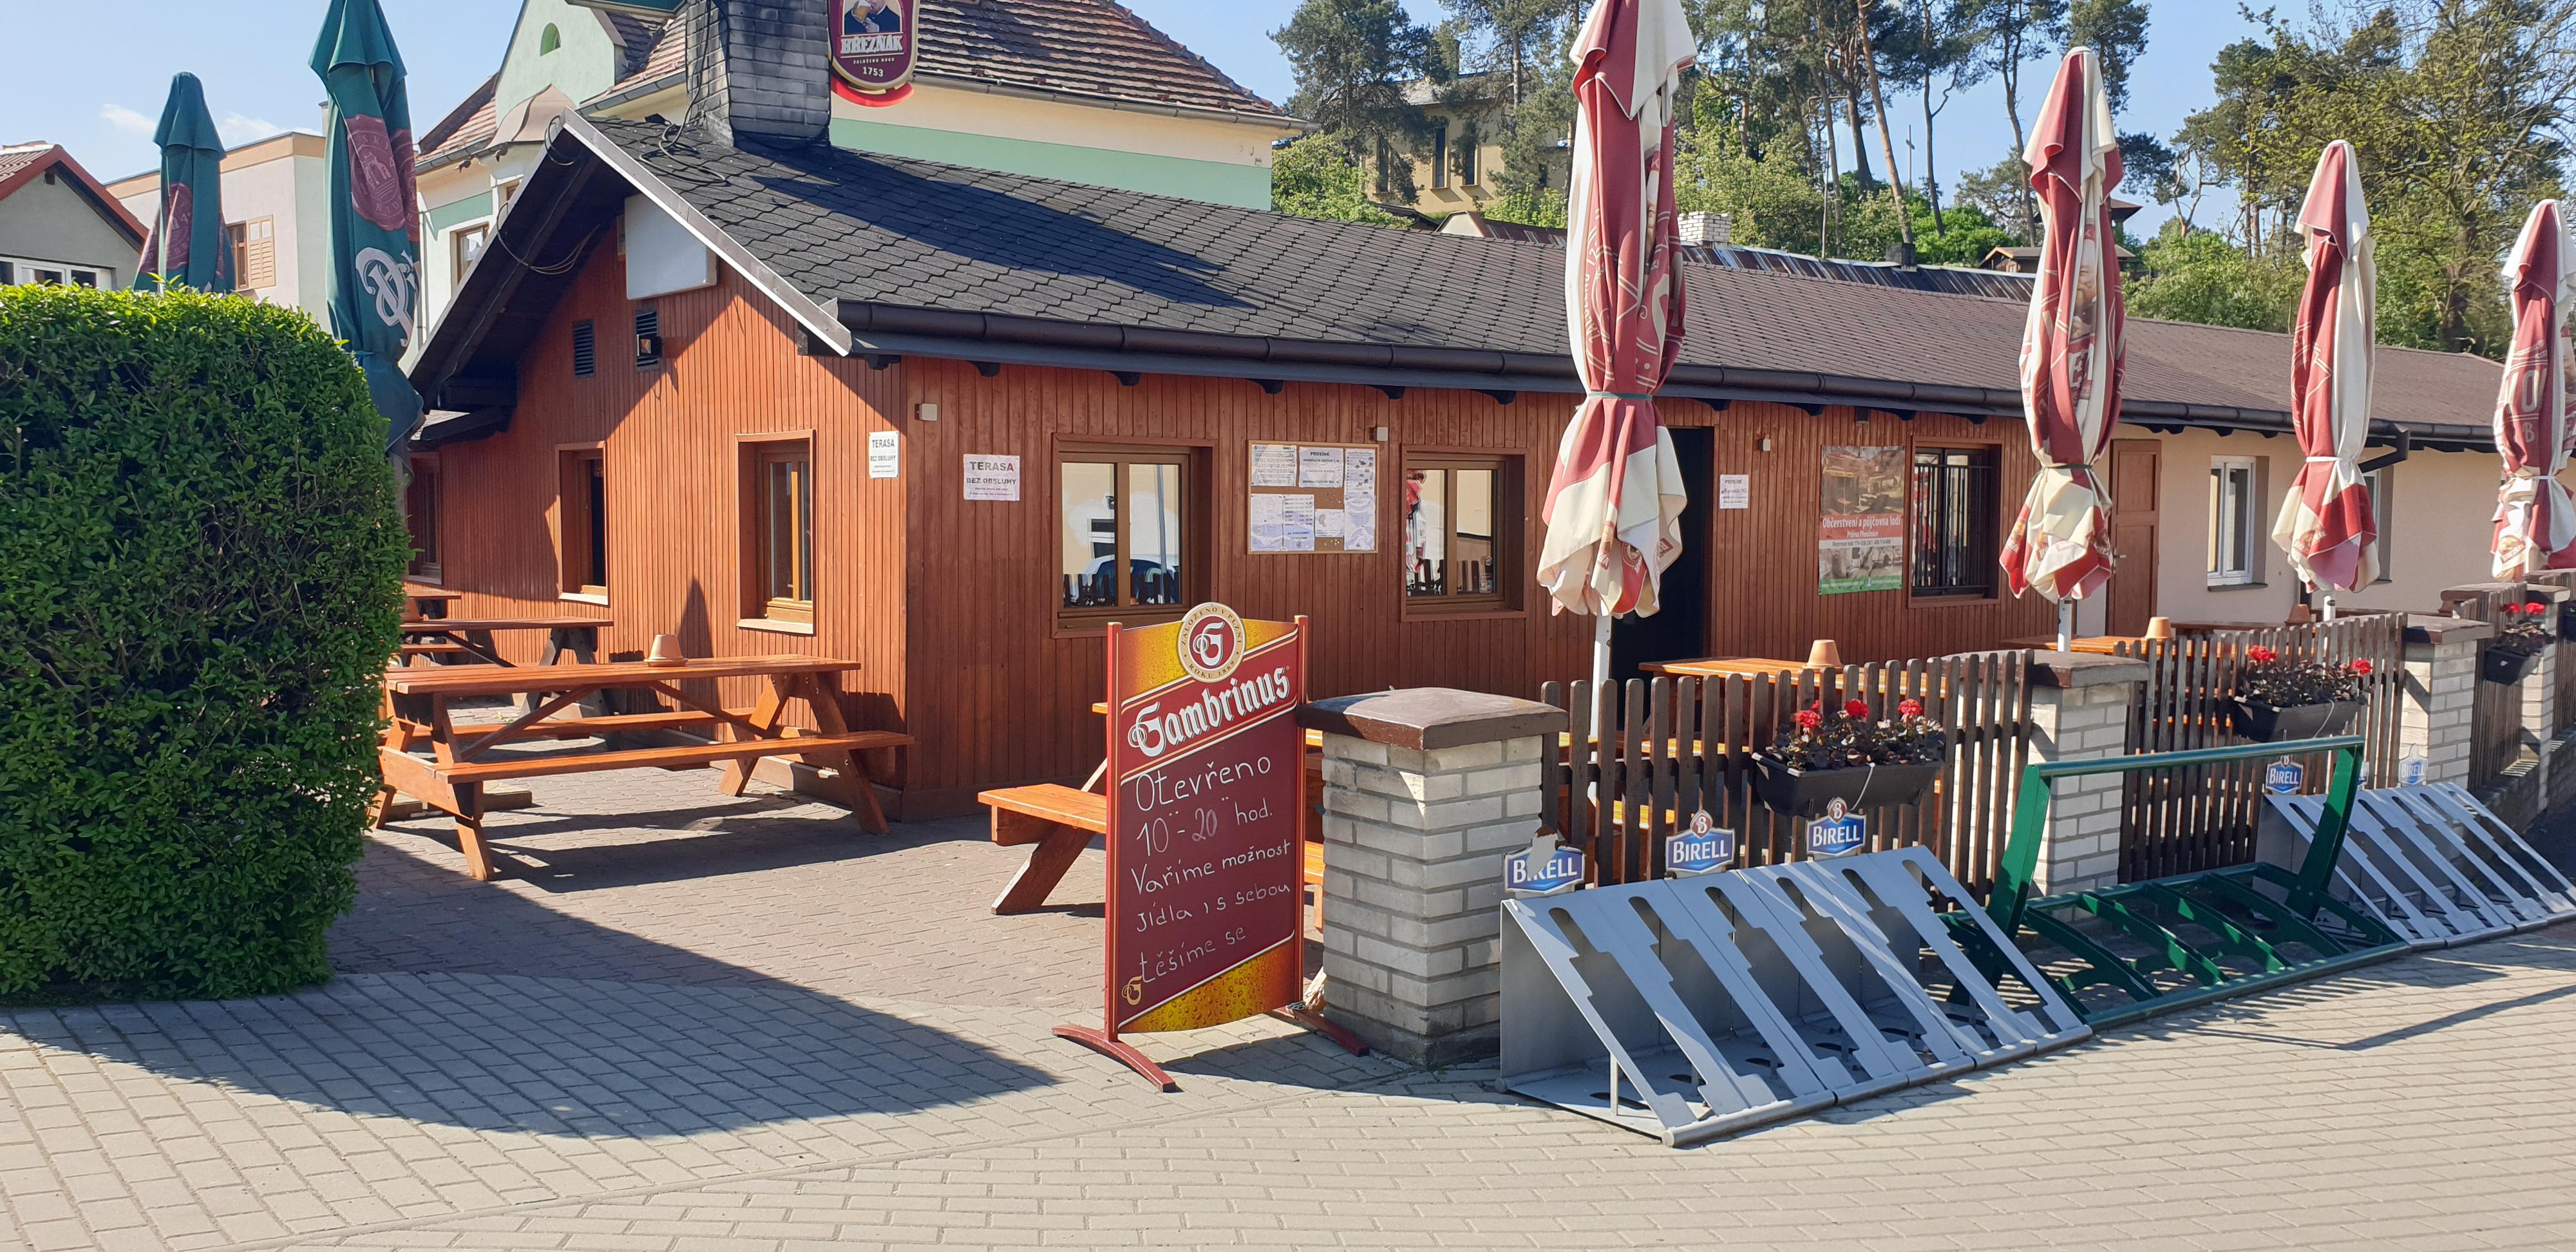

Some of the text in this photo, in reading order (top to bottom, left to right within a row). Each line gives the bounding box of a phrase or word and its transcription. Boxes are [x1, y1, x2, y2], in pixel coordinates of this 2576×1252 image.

[863, 66, 884, 77] 1753
[872, 439, 895, 448] TERASA
[969, 461, 1014, 471] TERASA
[1823, 516, 1858, 528] Občerstvení
[1181, 607, 1218, 645] ZALOŽENO
[1189, 661, 1235, 678] ROKU 1869
[1128, 667, 1289, 757] Gambrinus
[2269, 768, 2298, 784] BIRELL
[2401, 763, 2425, 779] BIRELL
[1136, 756, 1271, 812] Otevřeno
[1235, 797, 1273, 826] hod.
[1813, 824, 1860, 847] BIRELL
[1673, 840, 1728, 864] BIRELL
[1131, 839, 1291, 895] Vaříme možnost
[1235, 883, 1290, 905] sebou
[1226, 927, 1246, 945] se
